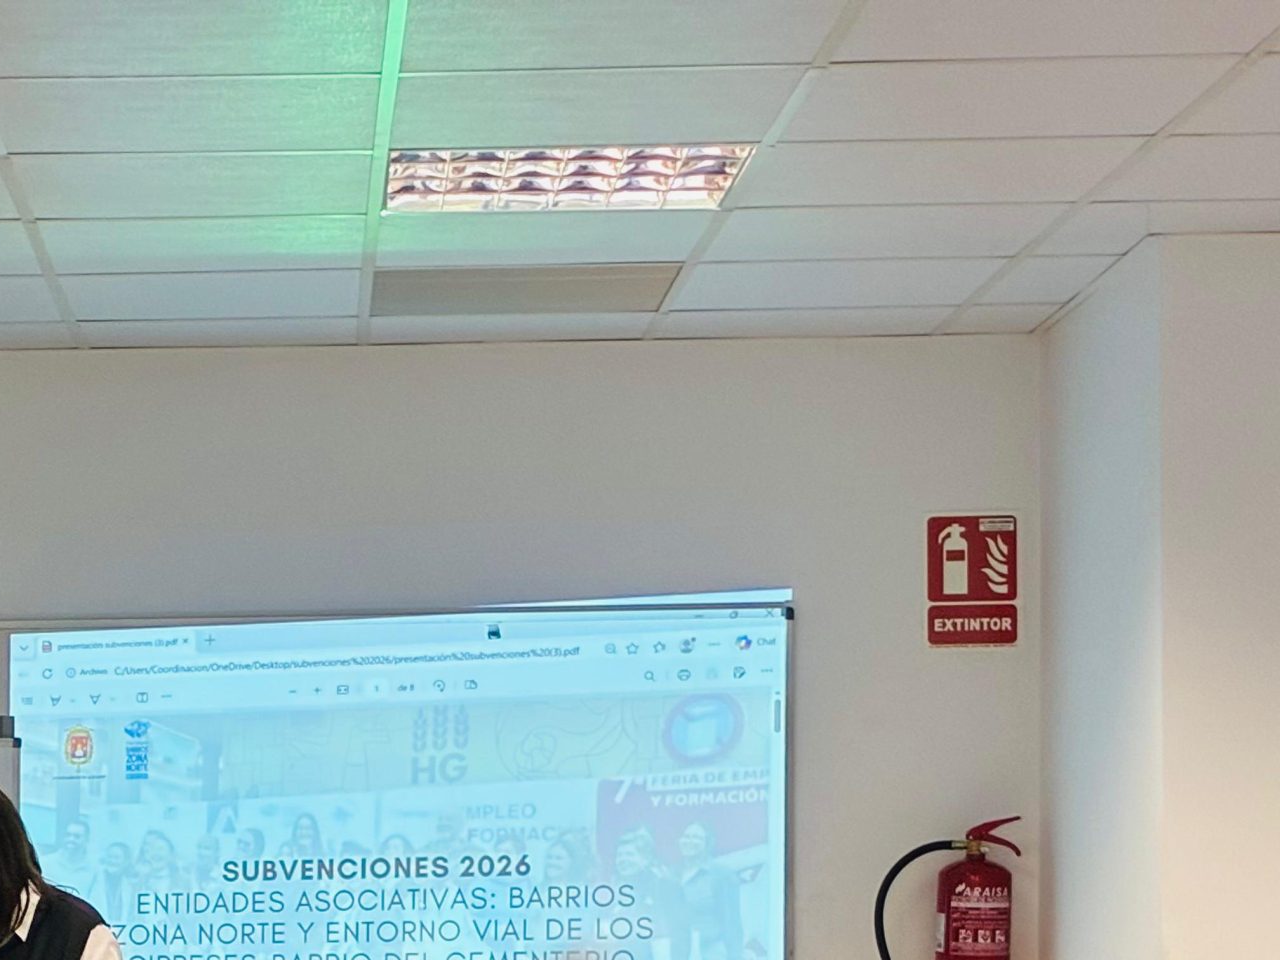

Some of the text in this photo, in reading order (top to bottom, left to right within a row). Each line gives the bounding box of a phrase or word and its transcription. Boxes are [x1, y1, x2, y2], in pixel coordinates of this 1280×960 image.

[933, 617, 1012, 632] EXTINTOR
[756, 637, 777, 647] Chat
[411, 752, 468, 785] HG
[651, 775, 699, 788] FERIA
[704, 772, 724, 784] DE
[465, 802, 537, 820] MPLEO
[222, 854, 532, 882] SUBVENCIONES 2026
[136, 883, 636, 915] ENTIDADES ASOCIATIVAS: BARRIOS
[962, 885, 1009, 898] ARAISA
[113, 916, 654, 946] ZONA NORTE Y ENTORNO VIAL DE LOS
